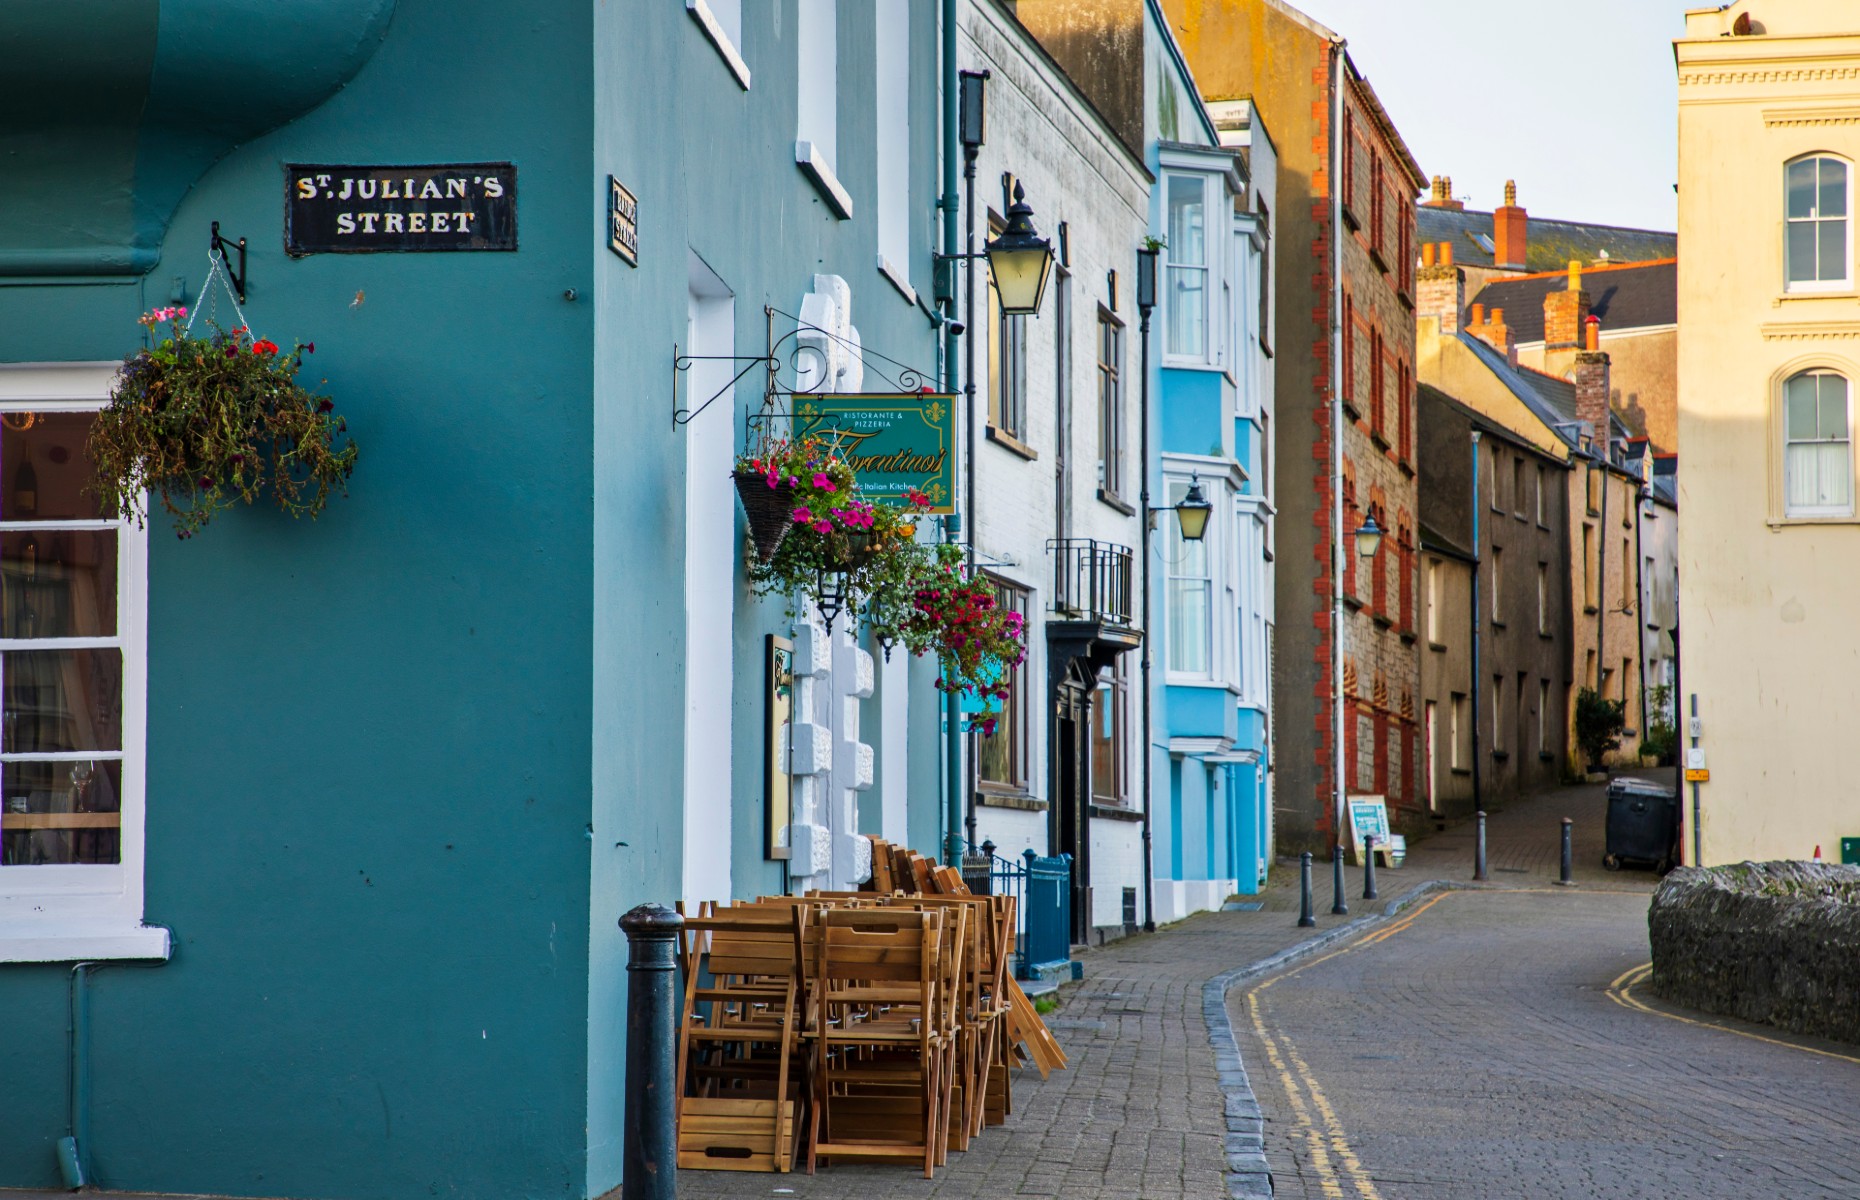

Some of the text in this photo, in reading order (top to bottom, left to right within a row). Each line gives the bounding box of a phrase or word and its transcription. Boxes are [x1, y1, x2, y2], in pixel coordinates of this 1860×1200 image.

[338, 176, 504, 200] JULIAN'S
[336, 212, 476, 235] STREET
[843, 411, 903, 419] RISTORANTE &
[854, 420, 891, 428] PIZZERIA
[864, 482, 888, 490] Italian
